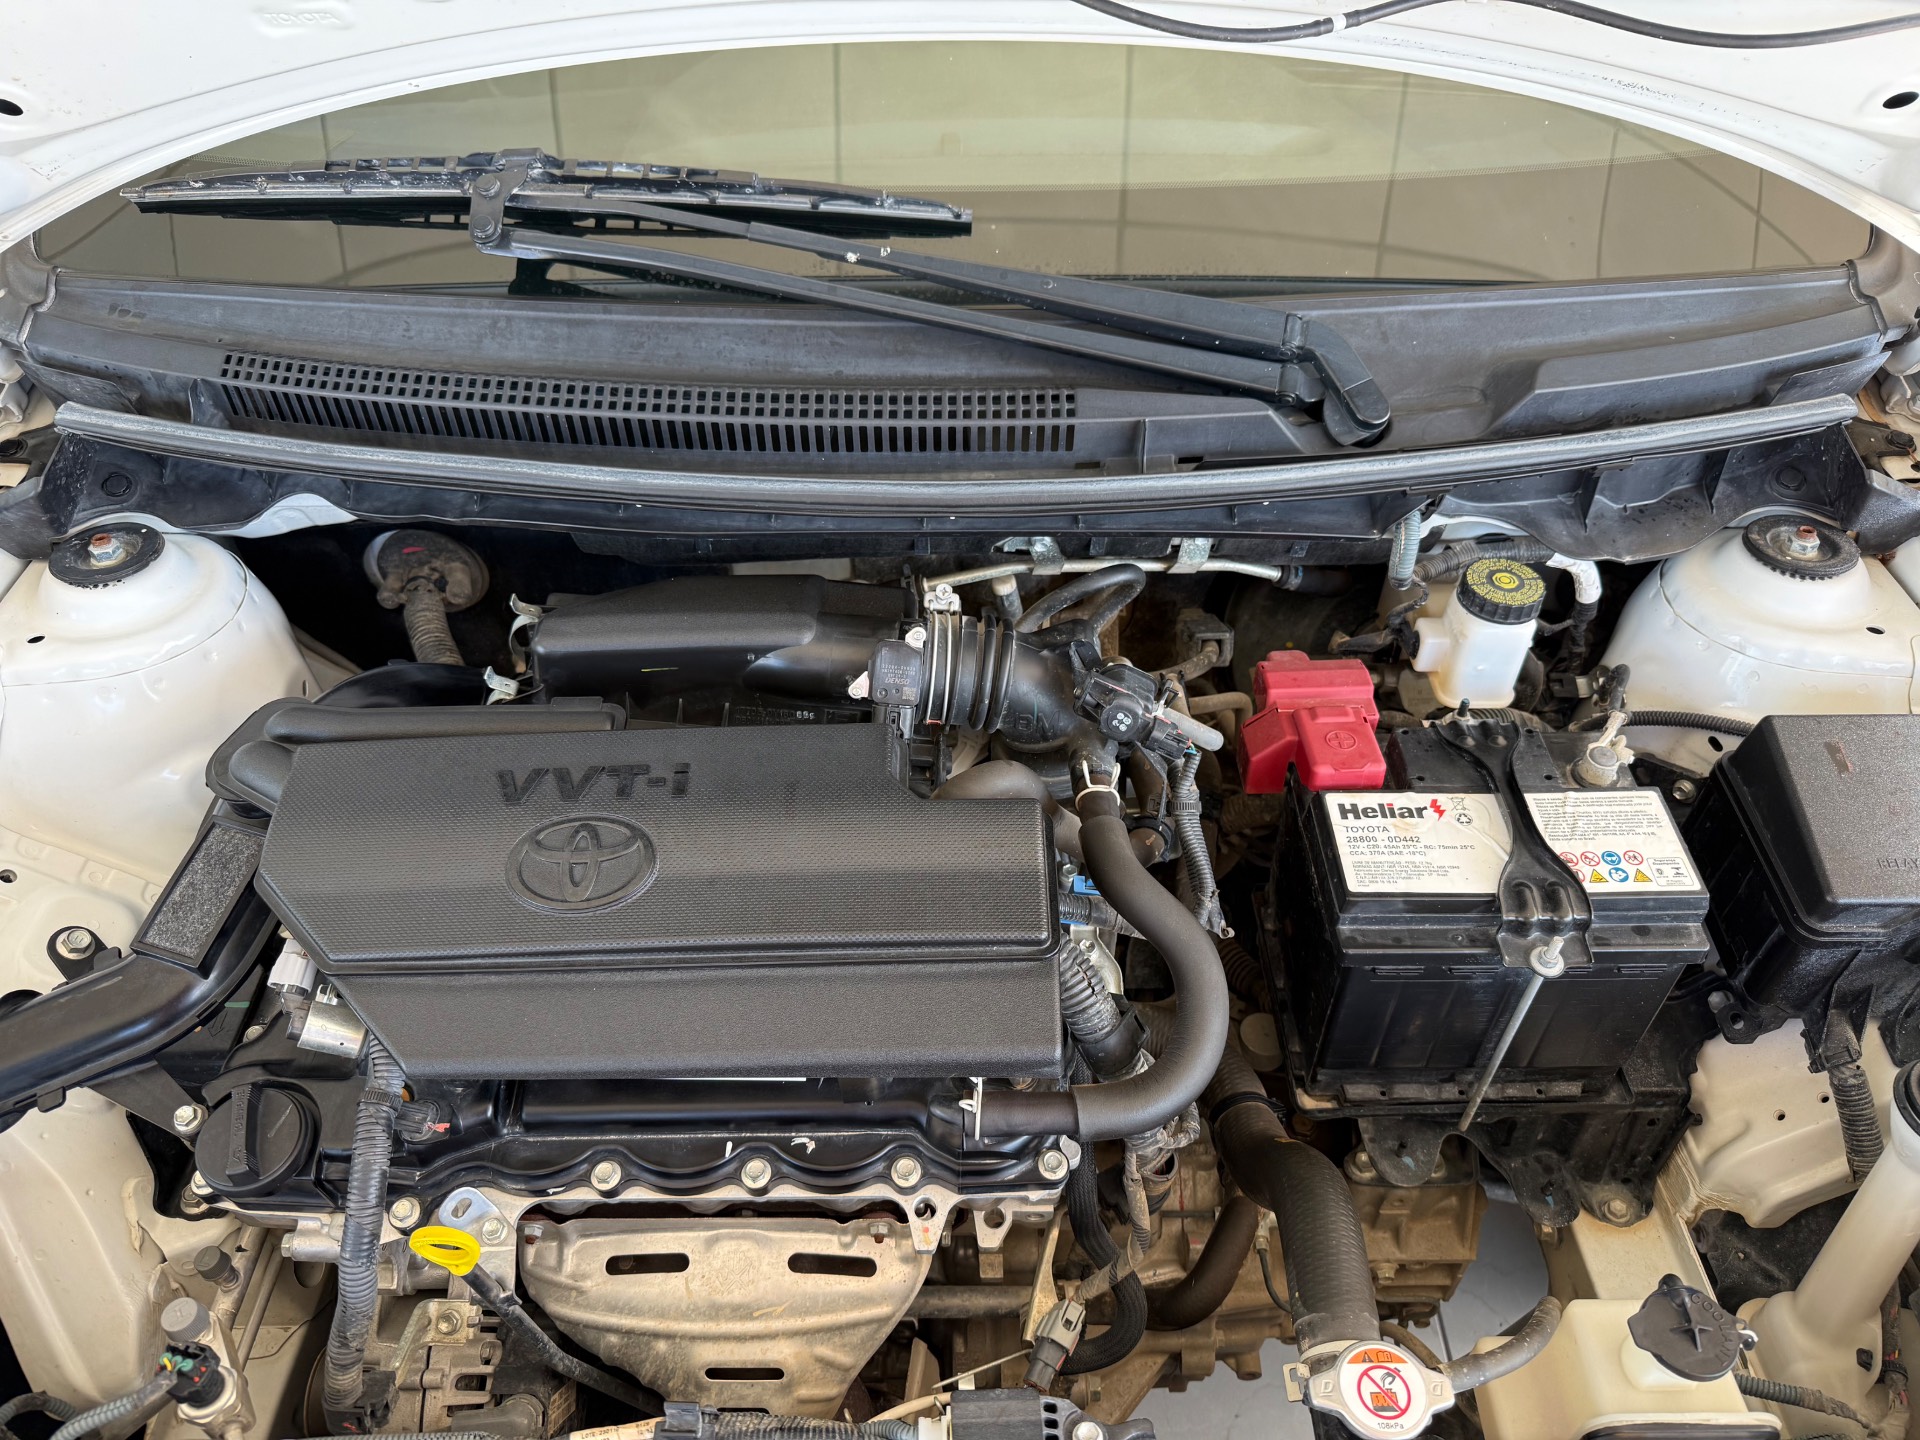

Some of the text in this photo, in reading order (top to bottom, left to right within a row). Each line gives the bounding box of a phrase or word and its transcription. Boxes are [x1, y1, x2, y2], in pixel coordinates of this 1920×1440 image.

[263, 12, 342, 24] TOYOTA
[884, 677, 910, 685] DENSO
[497, 763, 691, 803] VVT-i
[1337, 803, 1428, 820] Heliar
[1344, 825, 1390, 833] TOYOTA
[1690, 1293, 1738, 1367] COOLANT
[1377, 1421, 1405, 1430] 108kPa
